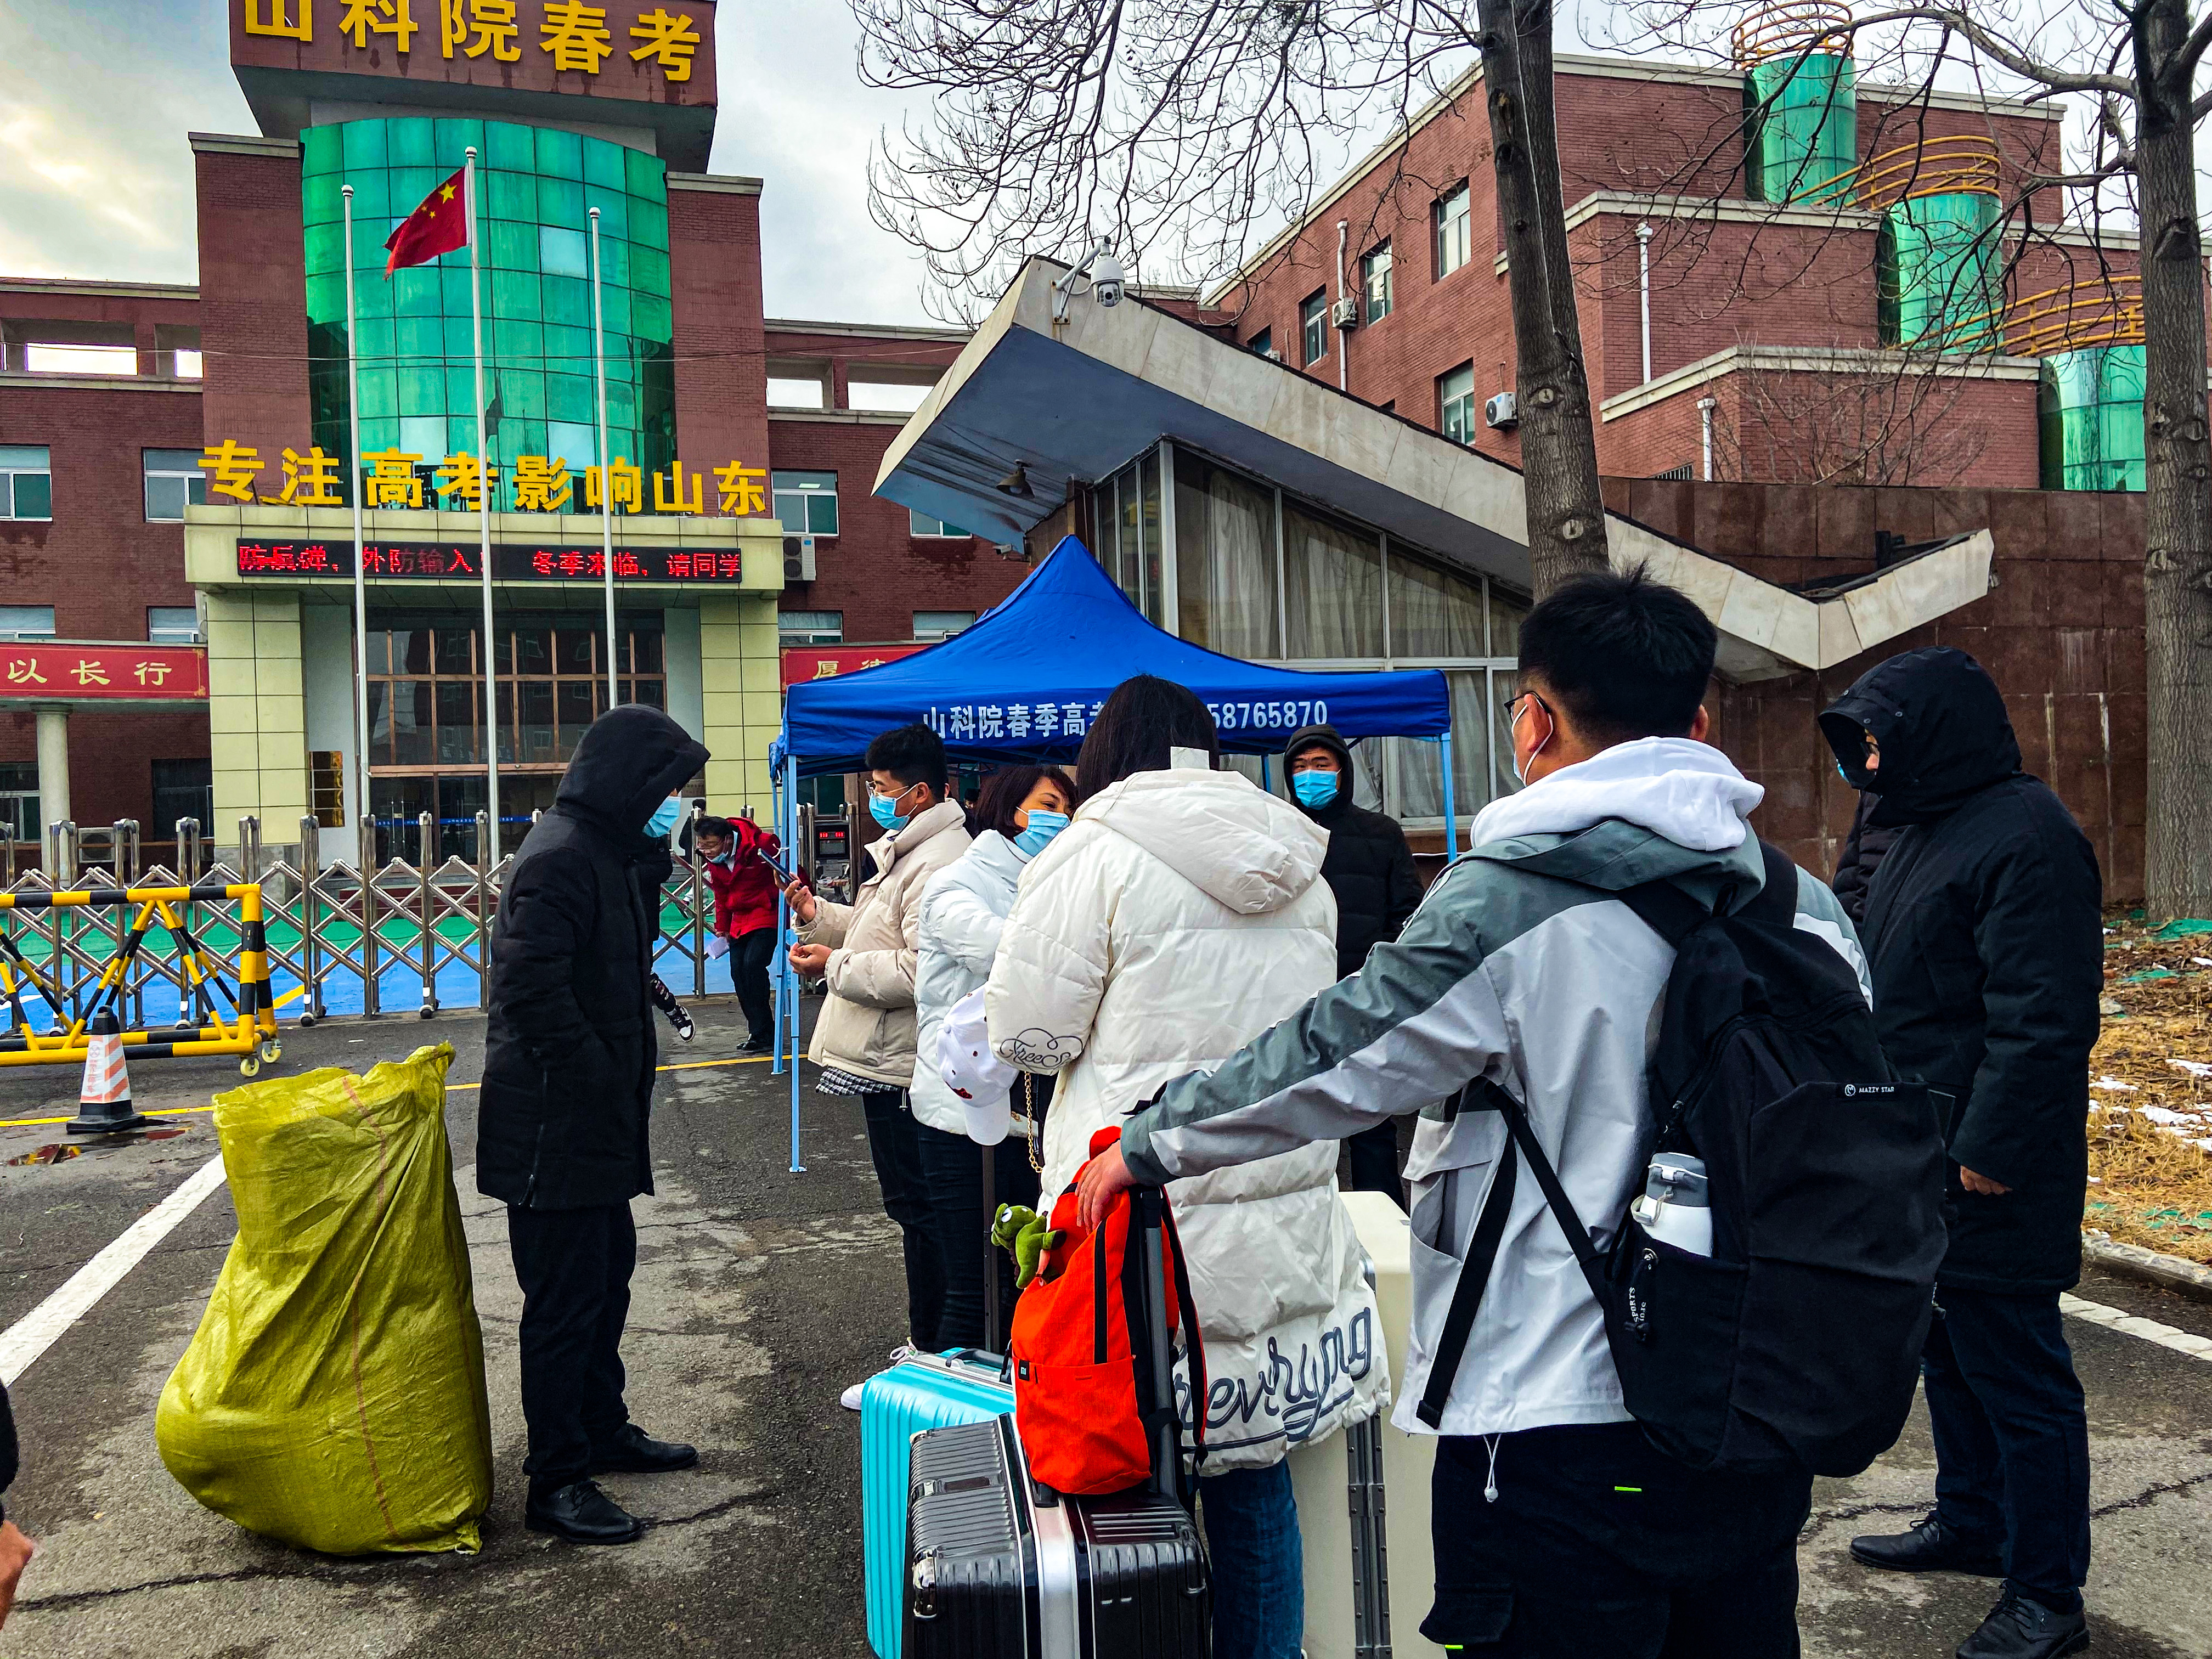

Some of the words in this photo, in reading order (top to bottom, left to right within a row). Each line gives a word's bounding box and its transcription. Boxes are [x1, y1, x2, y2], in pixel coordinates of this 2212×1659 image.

[244, 0, 701, 82] 山科院春考
[198, 439, 767, 515] 专注高考影响山东
[7, 658, 172, 685] 以长行
[1206, 700, 1328, 730] 58765870
[1628, 1286, 1639, 1323] SPORTS
